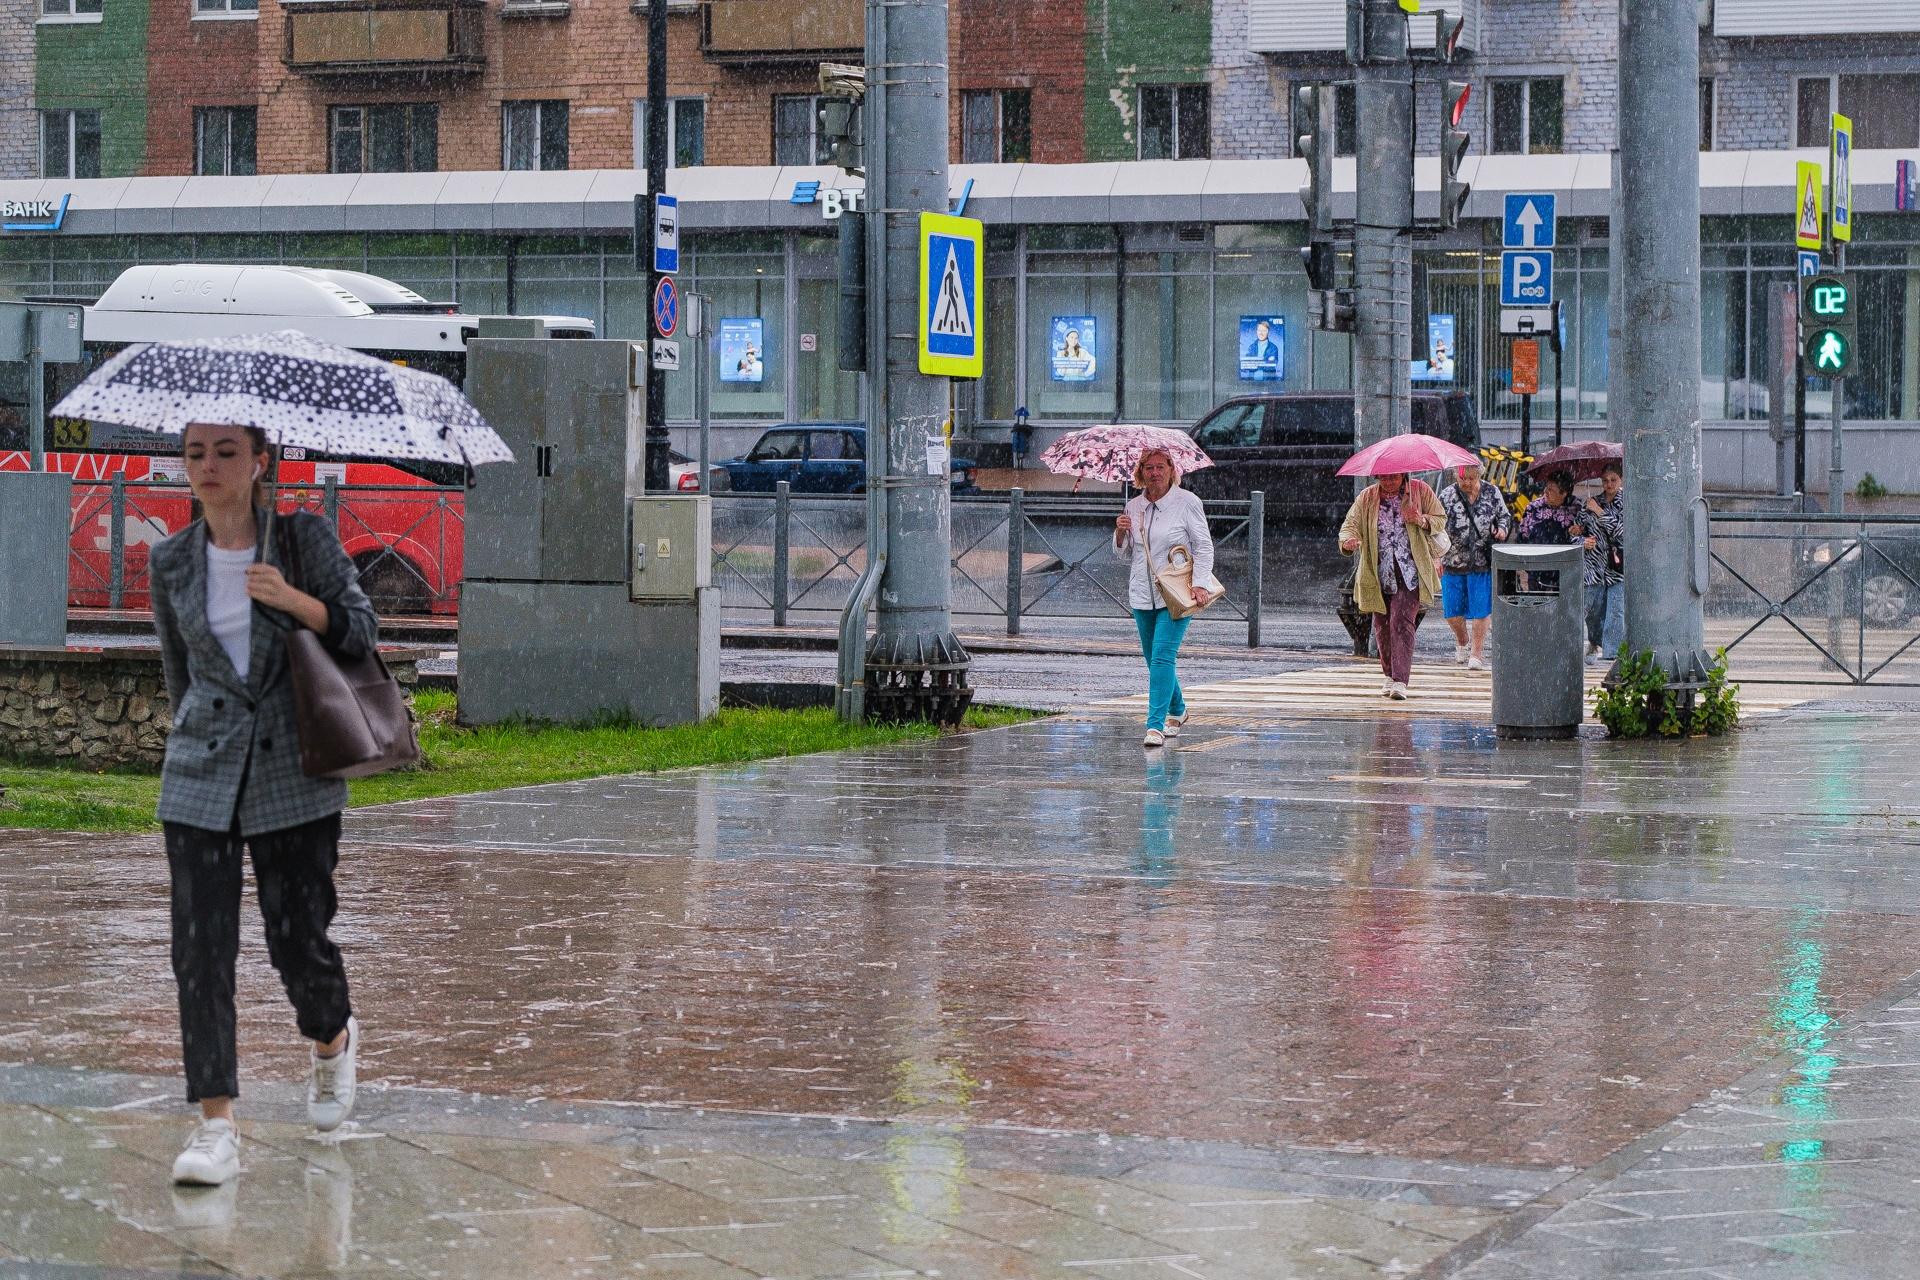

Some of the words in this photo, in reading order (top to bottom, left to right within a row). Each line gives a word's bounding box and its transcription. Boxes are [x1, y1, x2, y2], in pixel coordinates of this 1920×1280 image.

[3, 201, 51, 217] БАНК
[822, 188, 865, 219] ВТ
[171, 279, 215, 297] CNG
[1513, 256, 1541, 298] P
[1815, 287, 1846, 314] 02
[56, 417, 88, 446] 33
